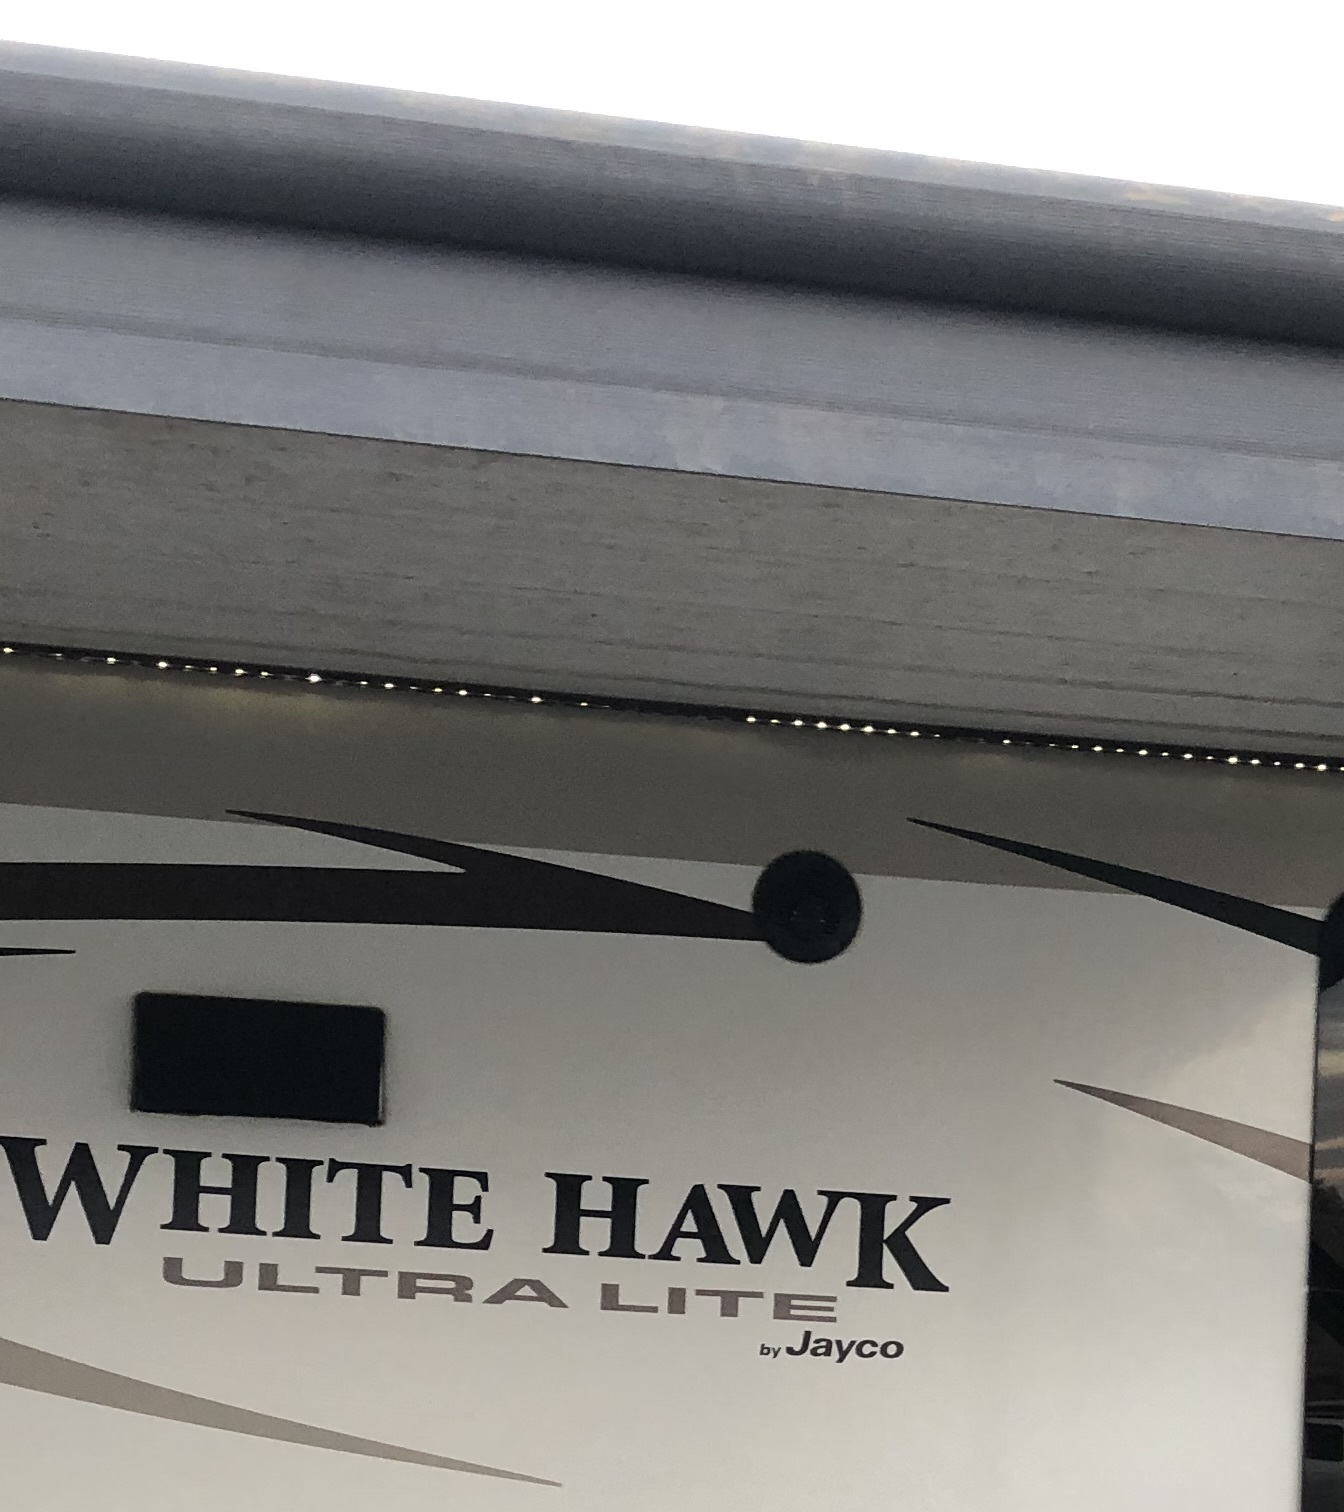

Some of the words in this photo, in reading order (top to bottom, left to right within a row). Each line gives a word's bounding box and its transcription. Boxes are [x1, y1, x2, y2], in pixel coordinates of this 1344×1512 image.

[542, 1172, 951, 1292] HAWK
[163, 1257, 569, 1309] ULTRA
[600, 1283, 837, 1323] LITE
[759, 1343, 781, 1359] by
[786, 1330, 904, 1363] Jayco
